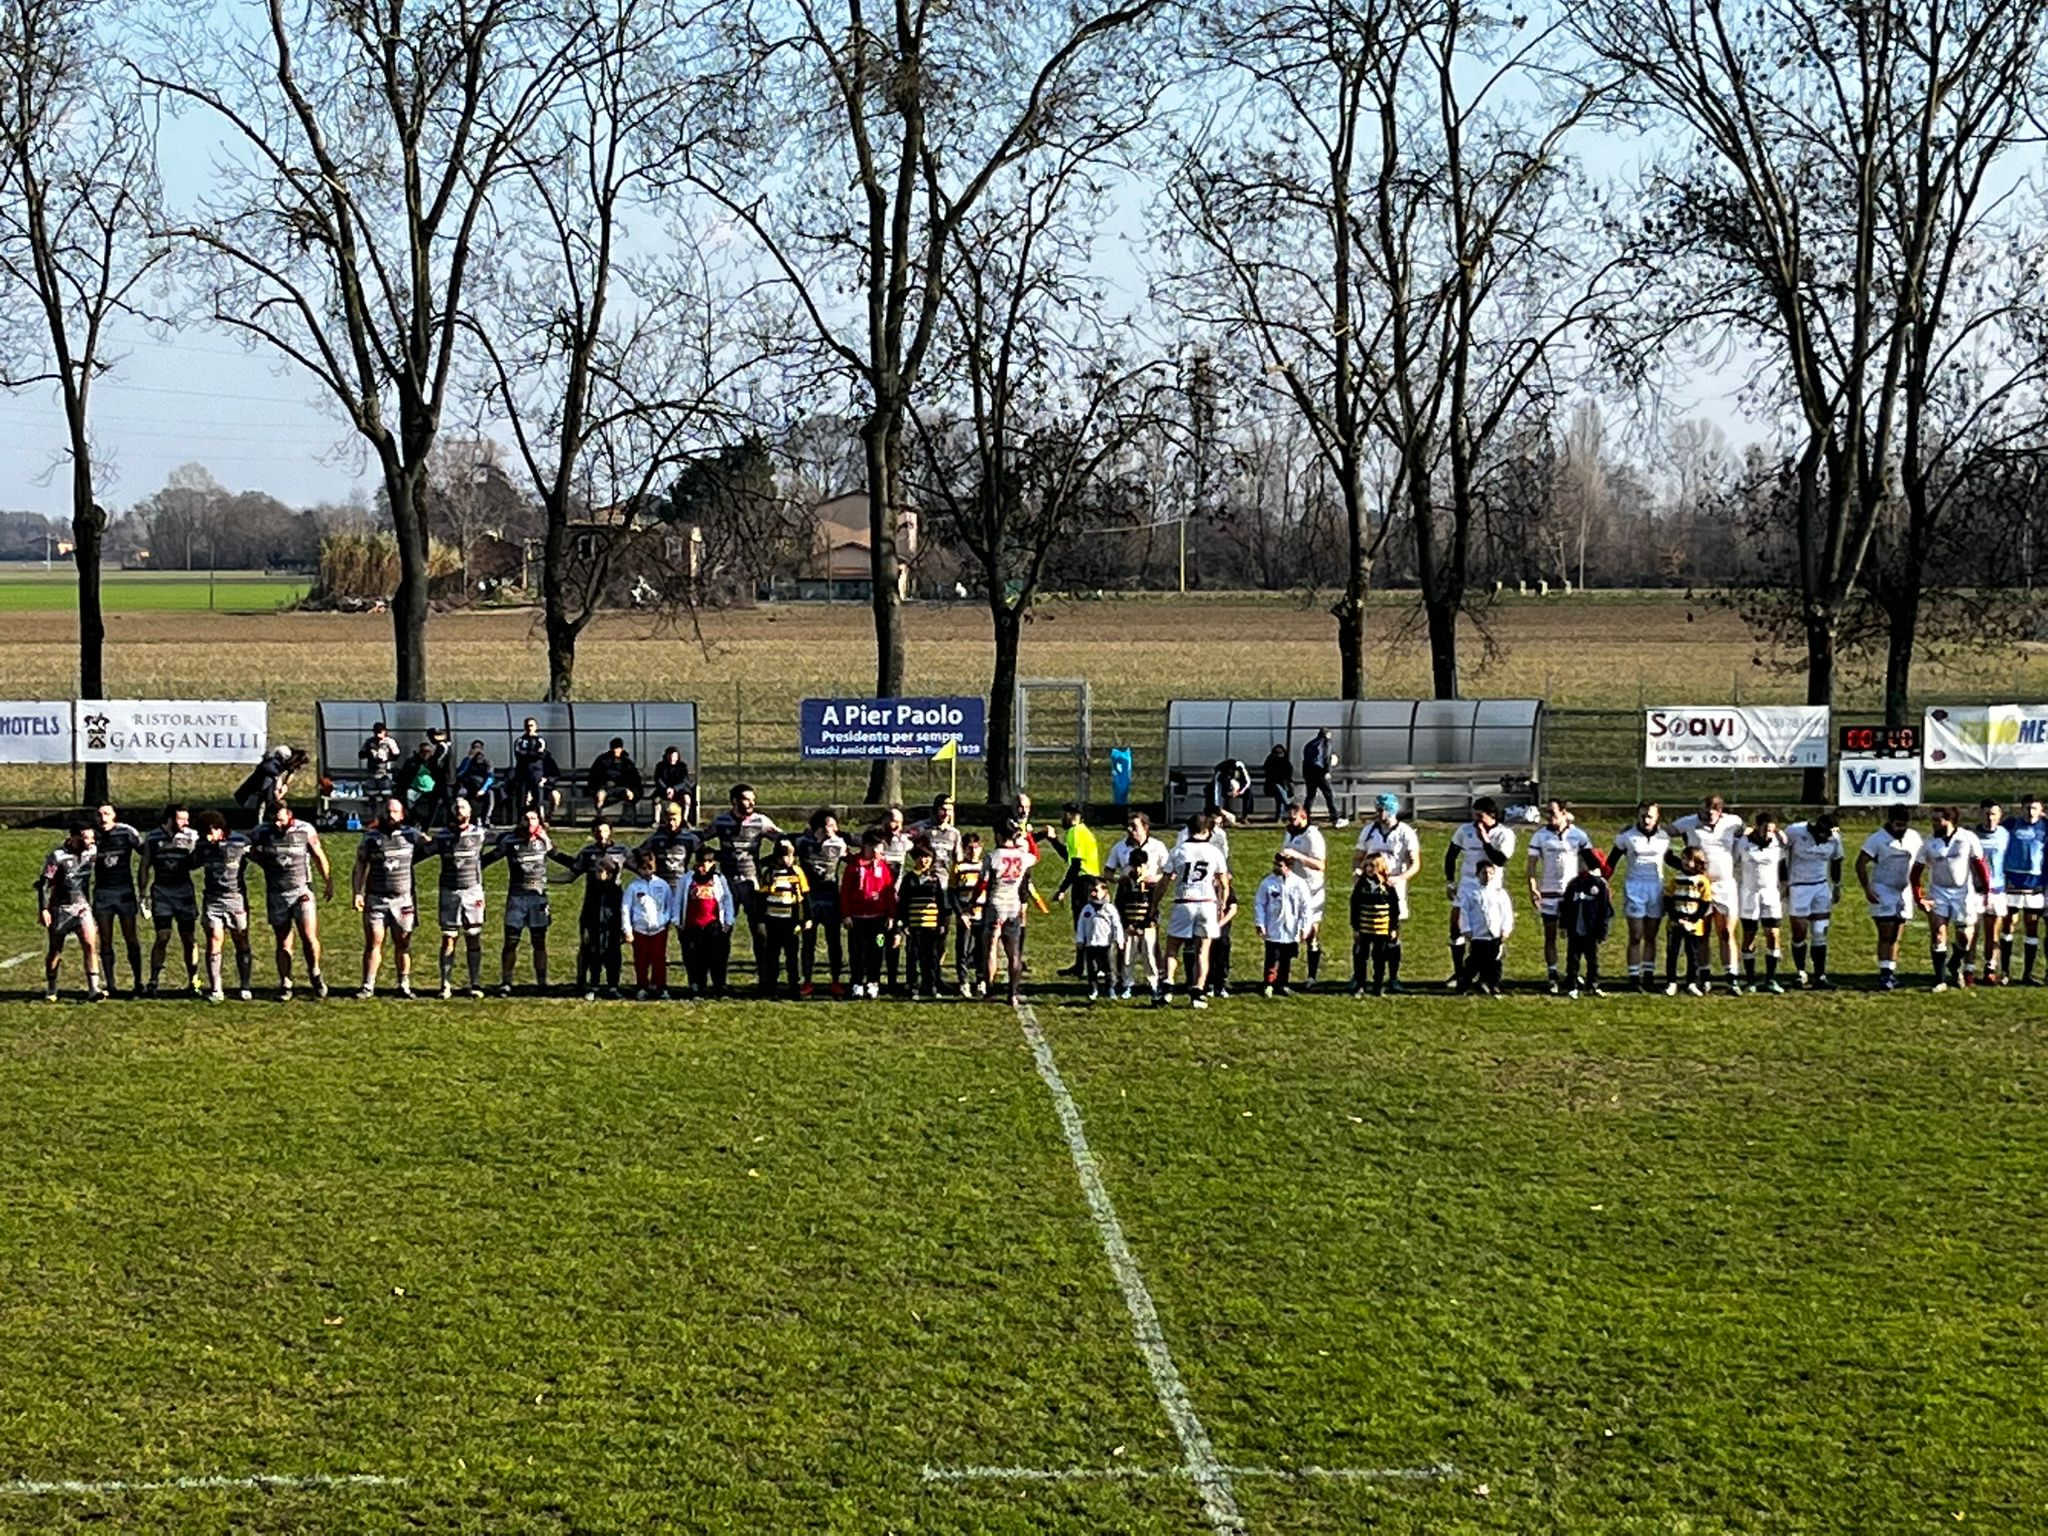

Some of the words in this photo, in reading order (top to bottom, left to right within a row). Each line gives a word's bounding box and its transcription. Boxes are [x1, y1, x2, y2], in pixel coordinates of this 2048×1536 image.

[0, 715, 60, 736] HOTELS
[133, 713, 239, 727] RISTORANTE
[821, 705, 840, 726] A
[845, 704, 892, 726] Pier
[897, 704, 964, 726] Paolo
[110, 731, 259, 753] GARGANELLI
[821, 731, 889, 742] Presidente
[892, 733, 914, 744] per
[916, 733, 964, 743] sempre
[1845, 767, 1914, 796] Viro
[1001, 857, 1023, 878] 23
[1182, 862, 1209, 882] 15
